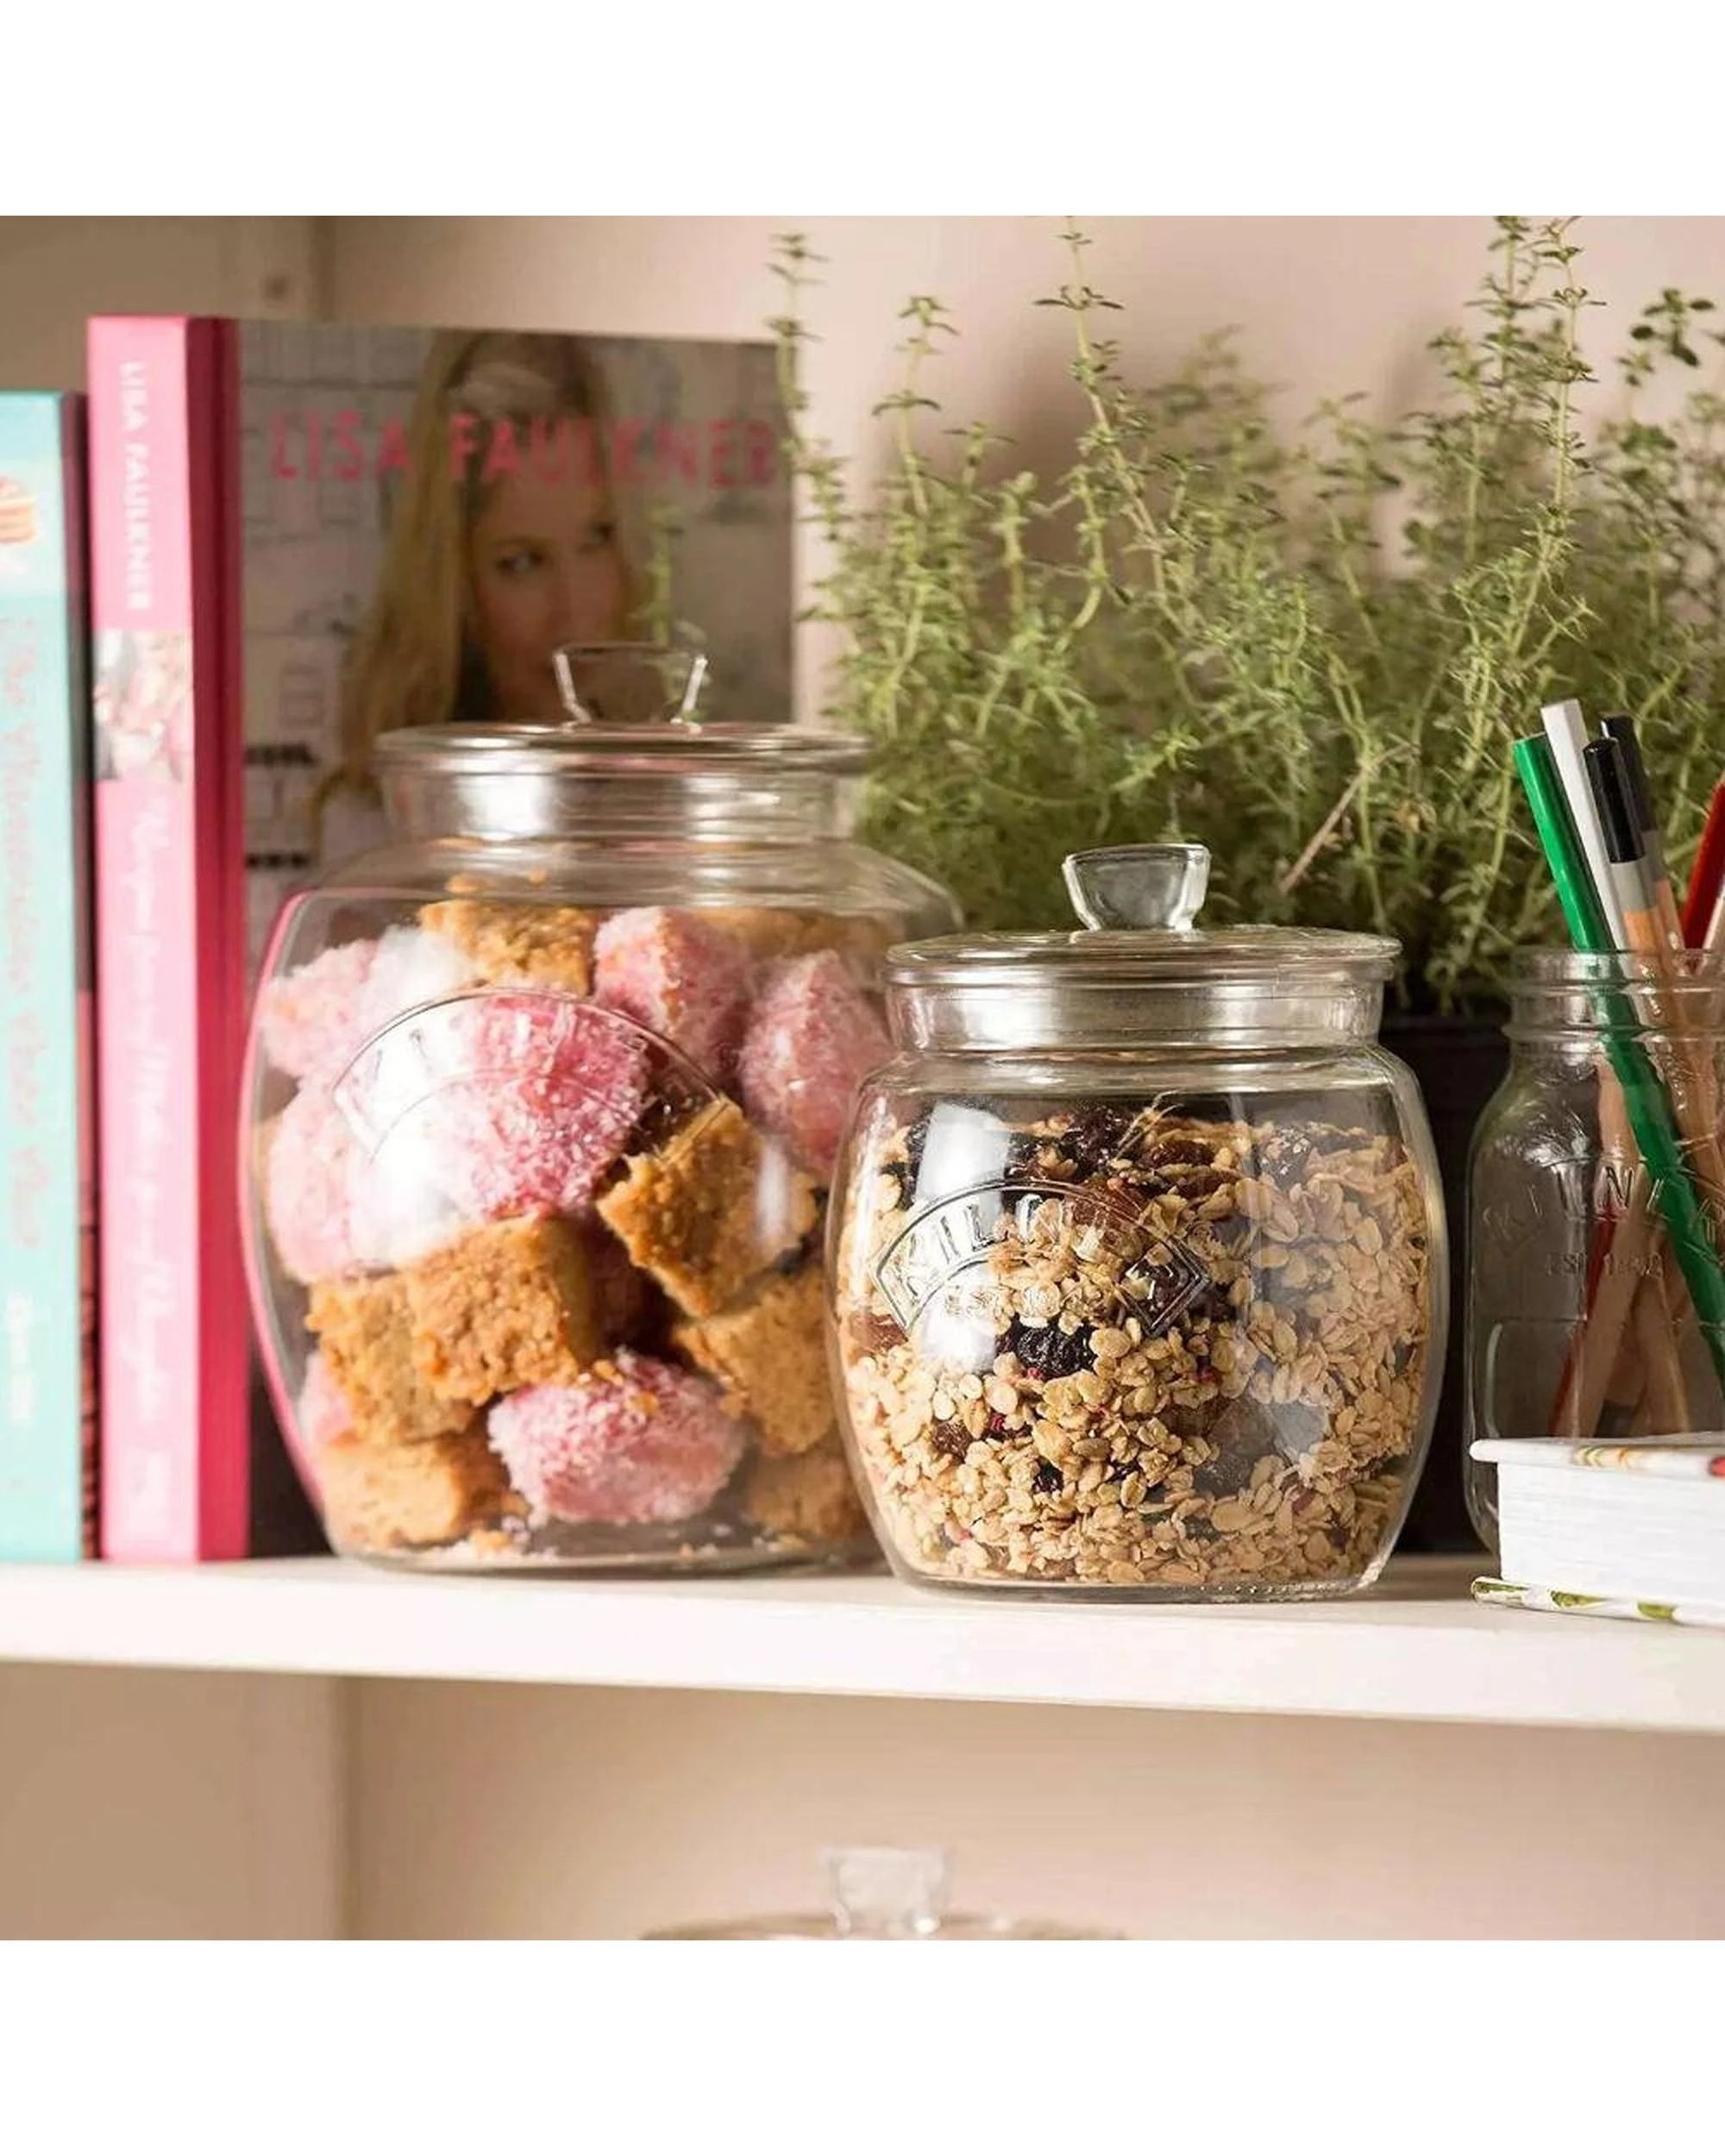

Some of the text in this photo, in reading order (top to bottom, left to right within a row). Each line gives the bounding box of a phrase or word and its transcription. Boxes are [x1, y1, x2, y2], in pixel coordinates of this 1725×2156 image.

[119, 360, 150, 432] LISA
[267, 407, 775, 489] LISA FAULKNER
